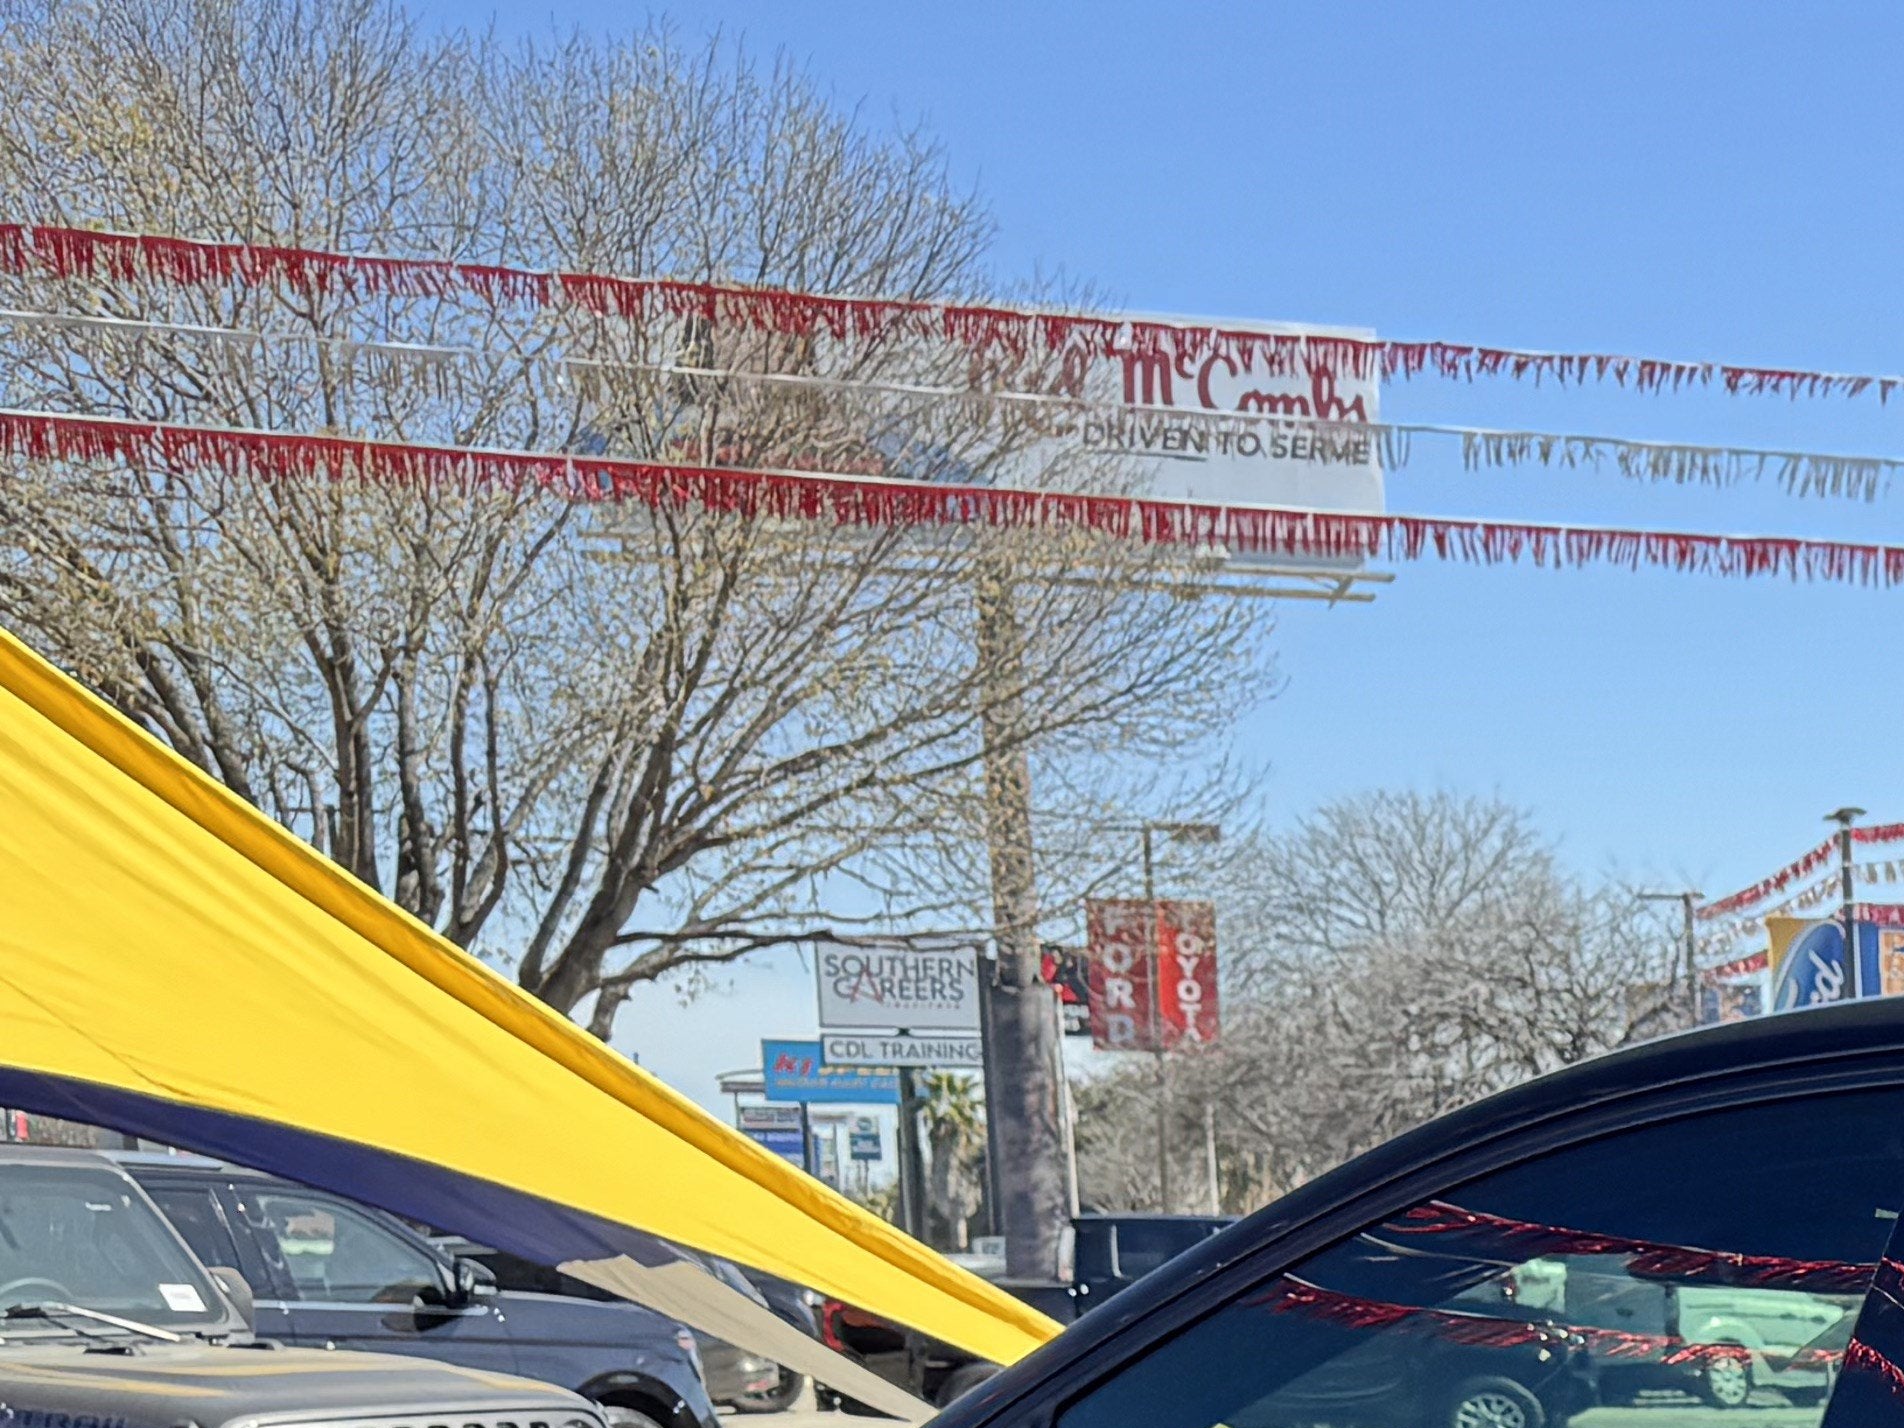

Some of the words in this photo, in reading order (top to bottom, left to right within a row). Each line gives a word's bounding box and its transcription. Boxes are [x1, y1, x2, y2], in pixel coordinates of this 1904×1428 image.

[1084, 421, 1205, 456] DRIVEN
[1214, 430, 1262, 456] TO
[824, 953, 975, 979] SOUTHERN
[1102, 905, 1136, 1044] FORD
[833, 969, 965, 1003] CAREERS
[829, 1040, 874, 1058] CDL
[879, 1041, 982, 1061] TRAINING
